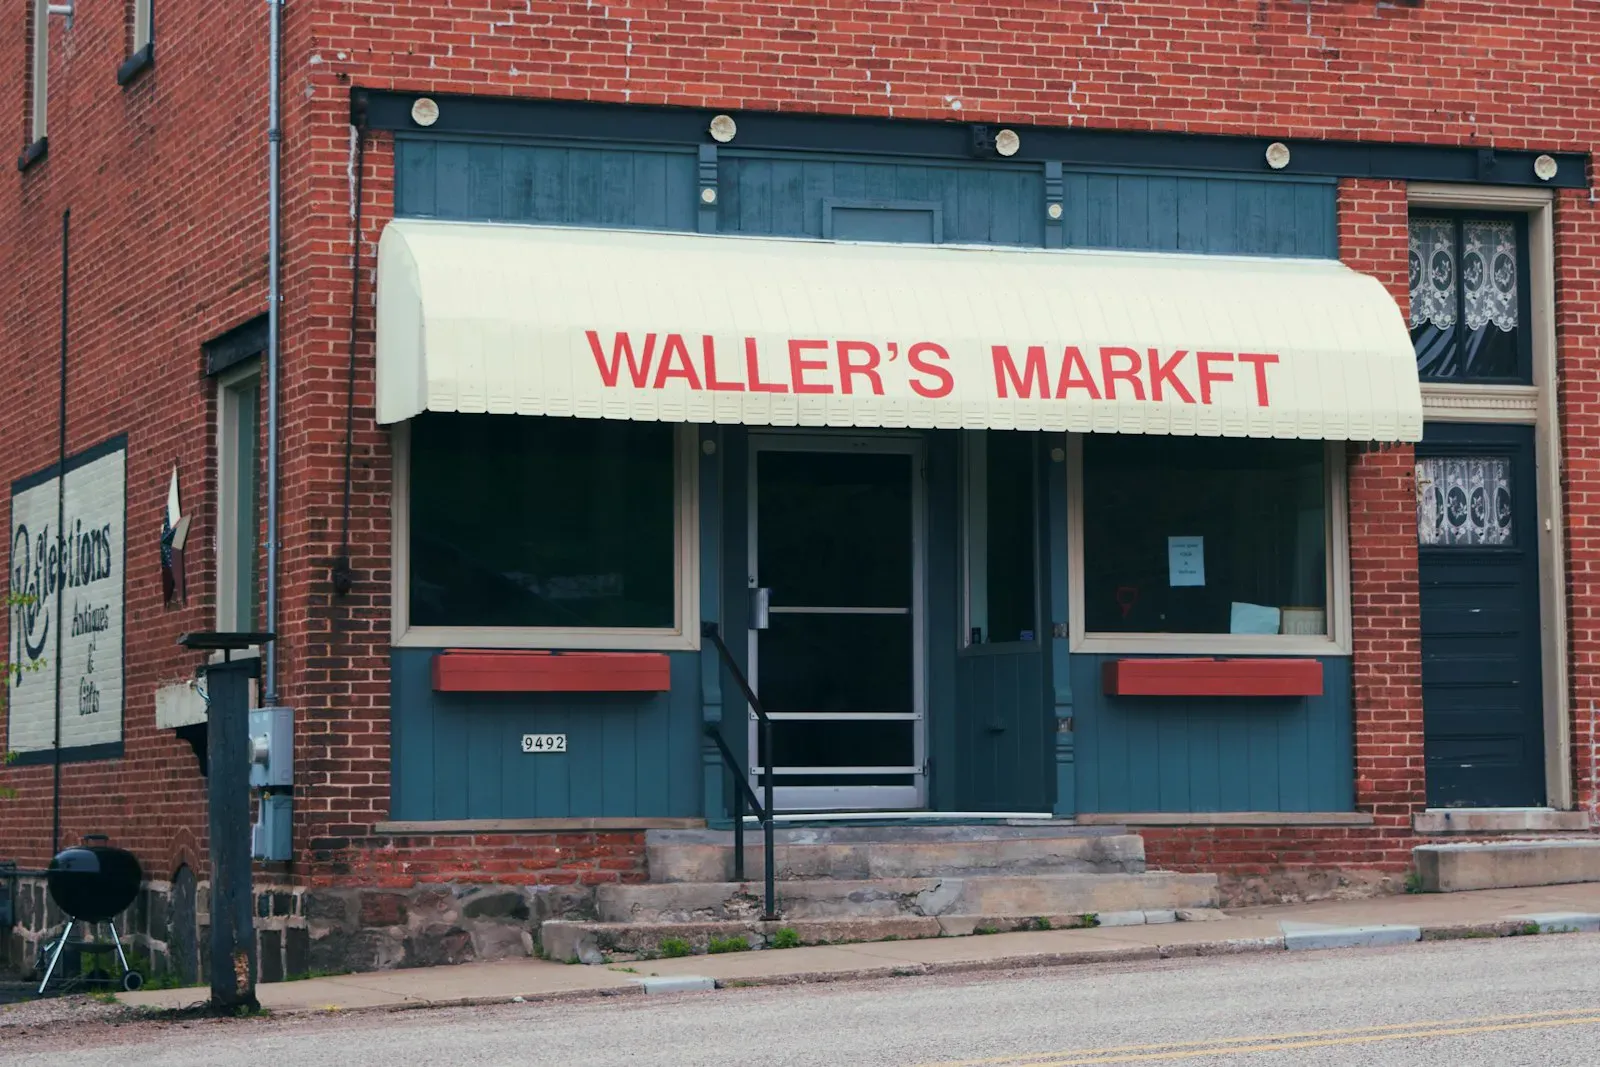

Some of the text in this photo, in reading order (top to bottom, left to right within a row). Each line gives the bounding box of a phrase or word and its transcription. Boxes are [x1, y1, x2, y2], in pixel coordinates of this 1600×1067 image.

[586, 331, 954, 398] WALLER'S
[12, 517, 112, 687] Reflections
[71, 595, 109, 651] Antiques
[87, 642, 95, 674] &
[79, 676, 100, 716] Gifts
[525, 736, 564, 750] 9492
